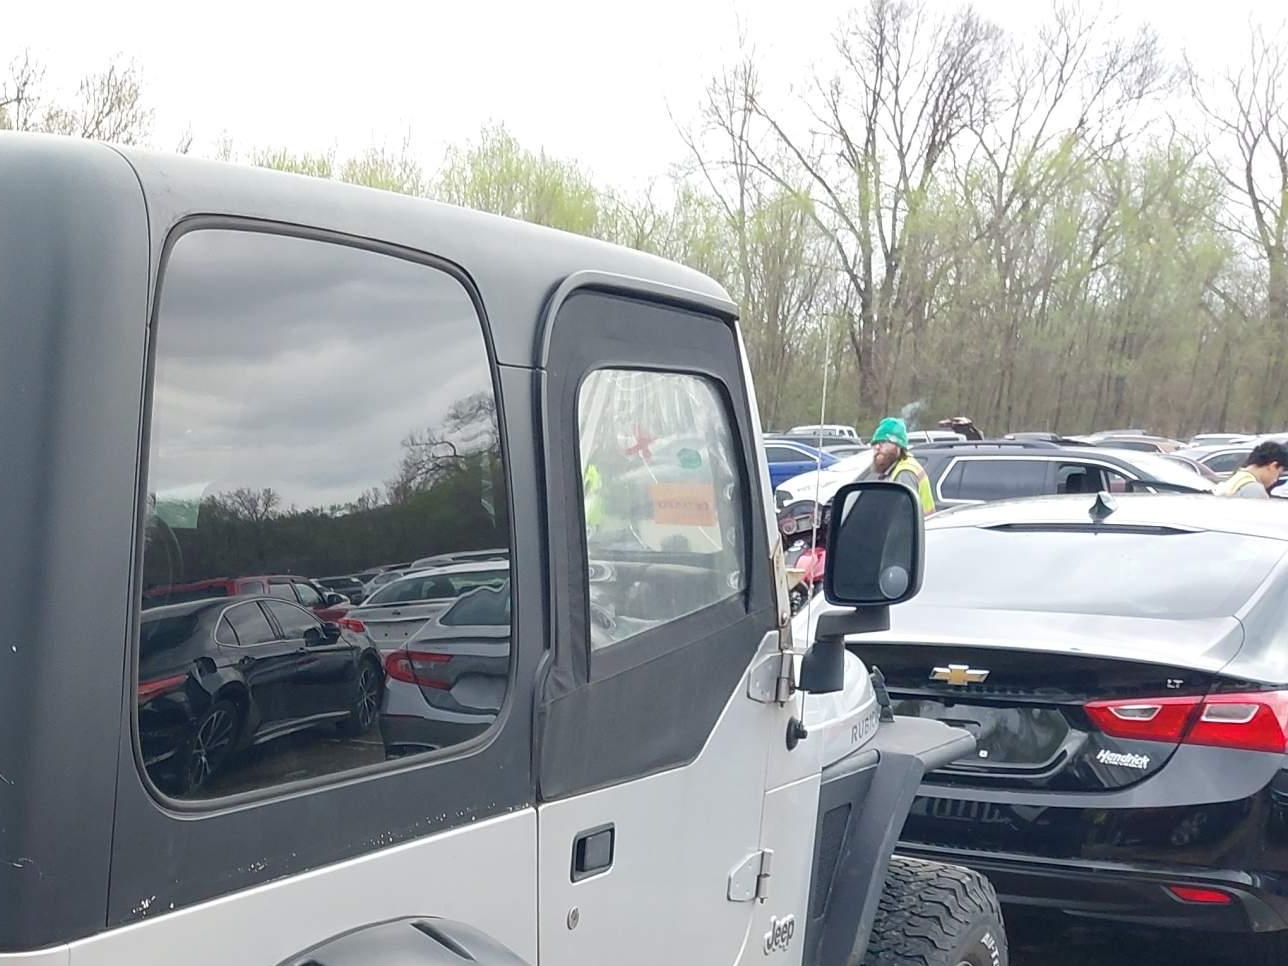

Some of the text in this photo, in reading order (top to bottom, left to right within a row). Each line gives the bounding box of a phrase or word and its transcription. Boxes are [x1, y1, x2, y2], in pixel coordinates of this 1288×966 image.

[1166, 679, 1184, 689] LT
[1096, 749, 1150, 769] Hendrick
[765, 915, 795, 953] Jeep
